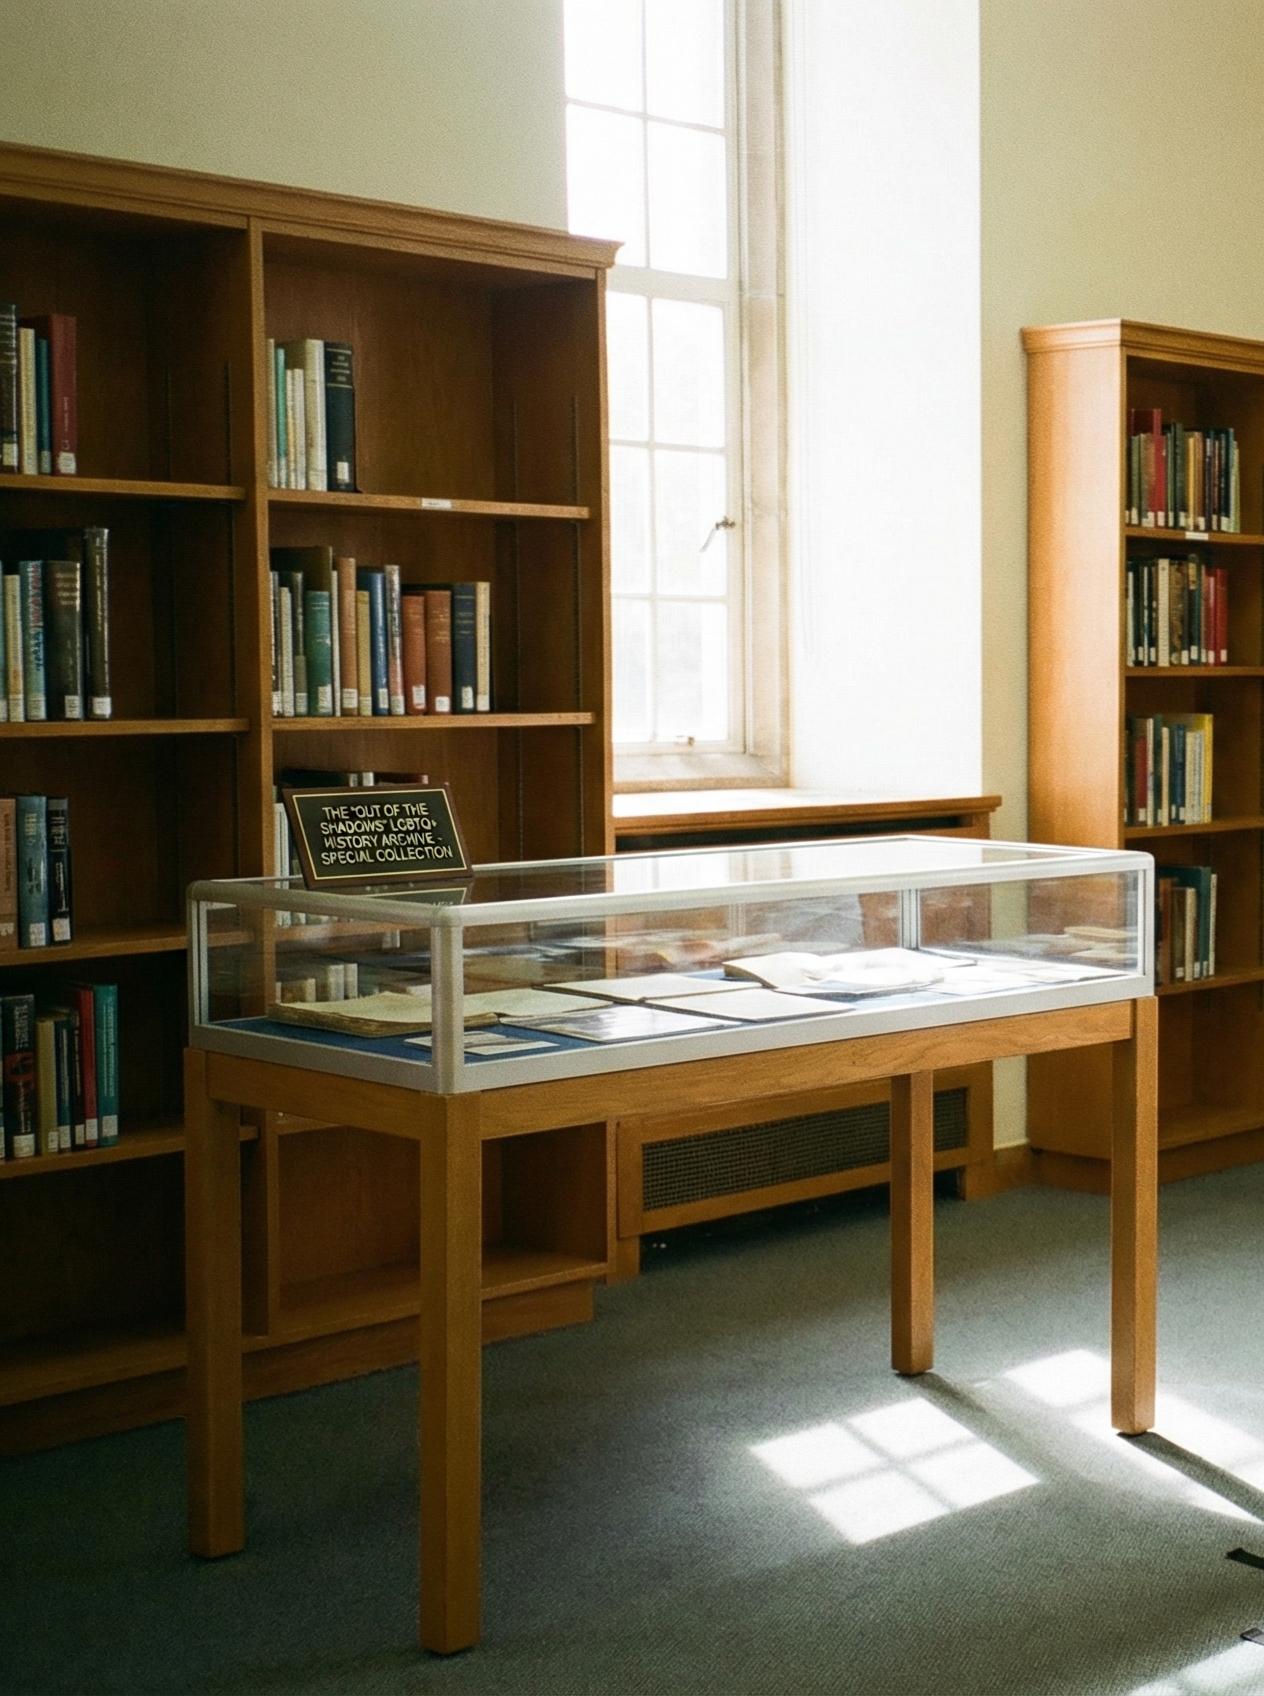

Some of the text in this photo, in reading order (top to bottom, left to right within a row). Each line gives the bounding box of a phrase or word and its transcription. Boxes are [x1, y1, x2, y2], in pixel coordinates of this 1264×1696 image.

[322, 806, 349, 820] THE
[384, 804, 400, 817] OF
[402, 803, 430, 816] THE
[321, 845, 454, 865] SPECIAL COLLECTION
